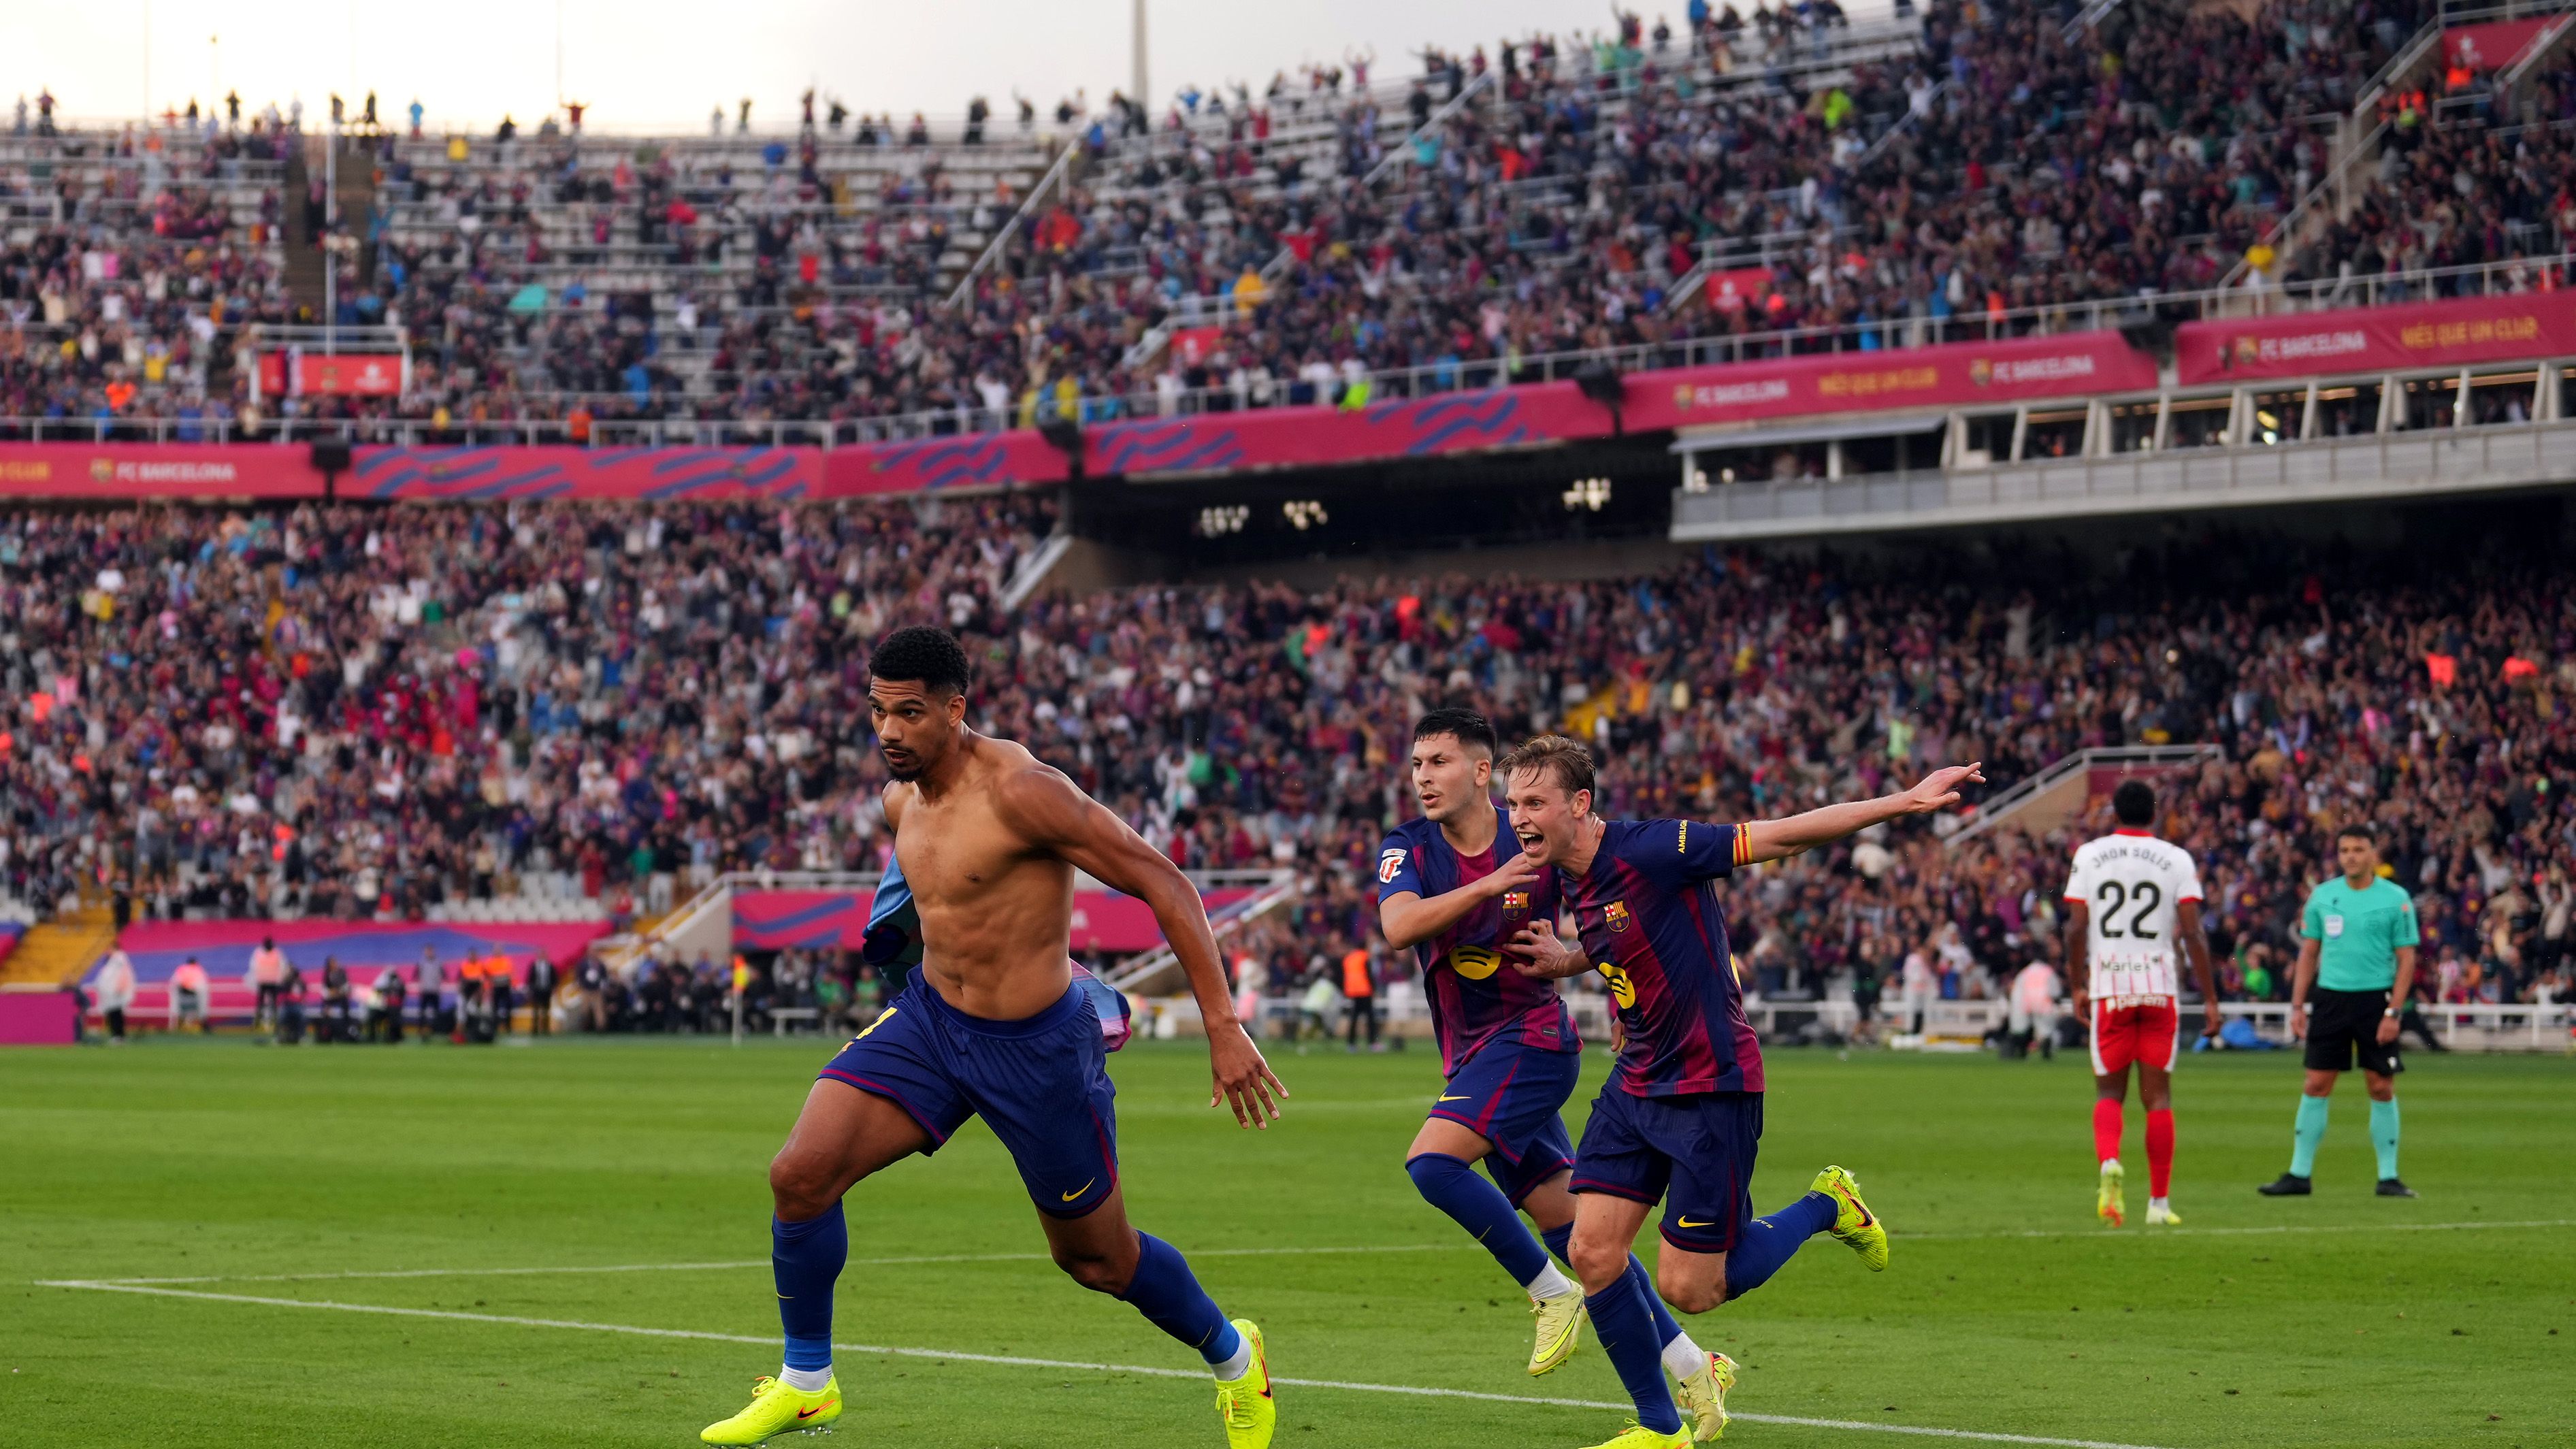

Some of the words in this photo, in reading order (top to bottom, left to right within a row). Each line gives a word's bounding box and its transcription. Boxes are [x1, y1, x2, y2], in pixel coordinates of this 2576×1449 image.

[2260, 339, 2278, 360] FC
[2281, 331, 2366, 359] BARCELONA
[2436, 322, 2466, 348] QUE
[2495, 316, 2538, 340] CLUB
[1993, 361, 2010, 384] FC
[2012, 354, 2093, 381] BARCELONA
[1713, 380, 1789, 405] BARCELONA
[139, 461, 235, 481] BARCELONA
[2092, 847, 2127, 868] JHON
[2098, 880, 2160, 939] 22
